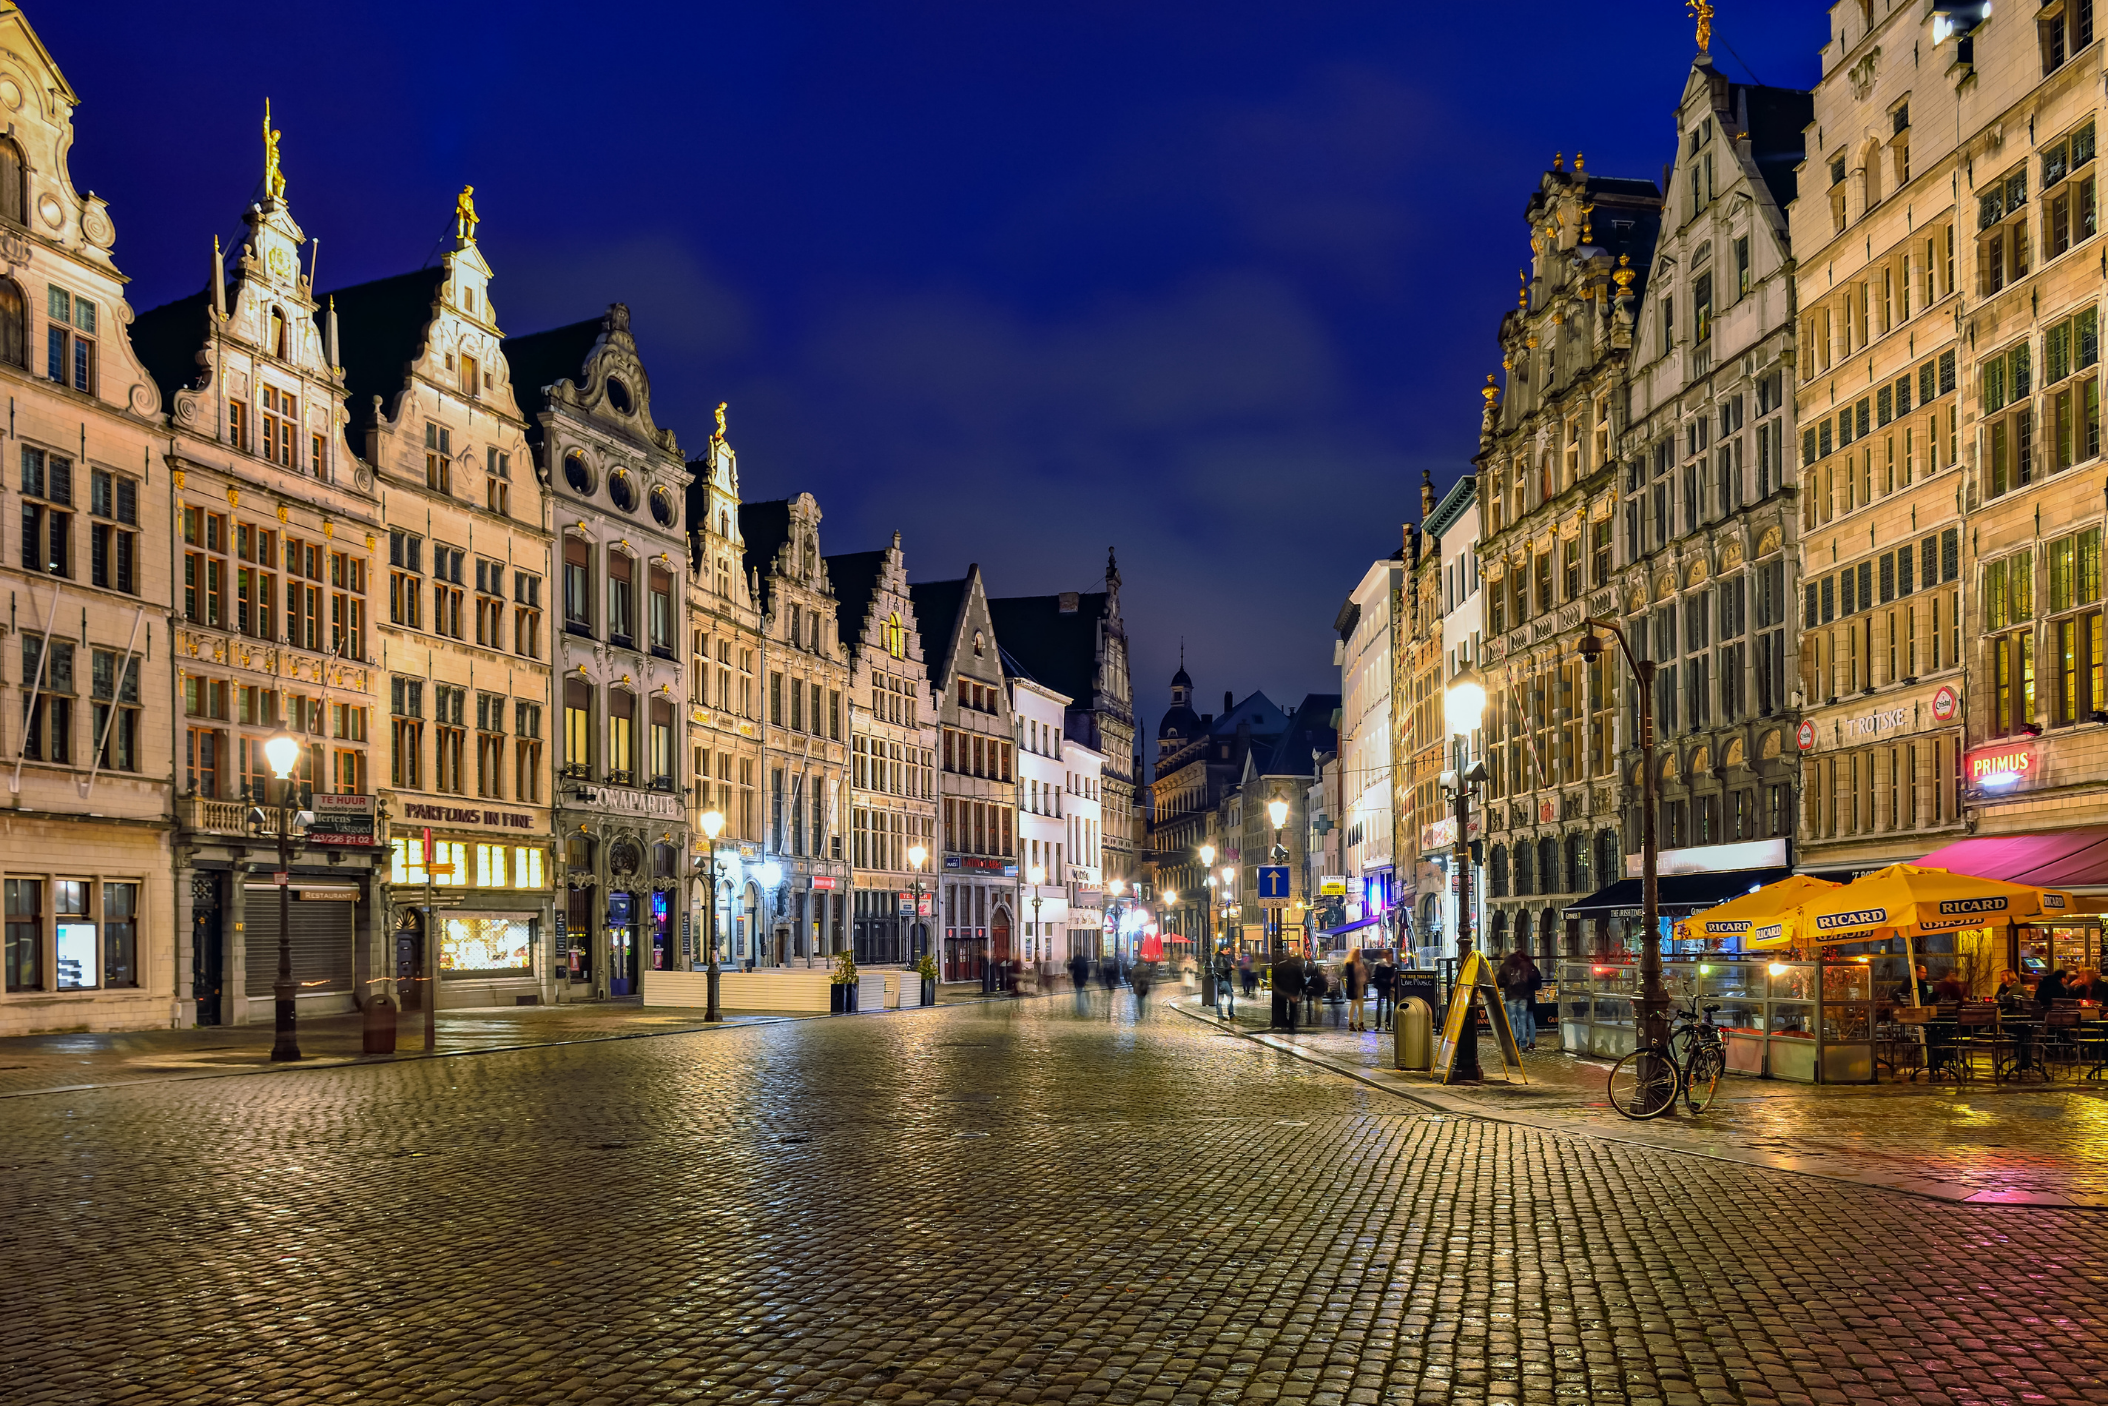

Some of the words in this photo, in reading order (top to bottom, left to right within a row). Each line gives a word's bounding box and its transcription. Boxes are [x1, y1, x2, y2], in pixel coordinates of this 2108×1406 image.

[1846, 719, 1855, 736] 'T
[1858, 708, 1906, 735] ROTSKE
[1974, 752, 2029, 776] PRIMUS
[320, 796, 333, 804] TE
[337, 796, 366, 805] HUUR
[586, 786, 674, 815] BONAPARTE
[405, 803, 480, 824] PARFUMS
[484, 811, 499, 825] IN
[502, 812, 534, 829] FINE
[334, 823, 372, 834] Vastgoed
[305, 891, 352, 899] RESTAURANT
[2044, 896, 2064, 907] RICARD
[1942, 899, 2005, 913] RICARD
[1819, 910, 1884, 928] RICARD
[1707, 922, 1751, 932] RICARD
[1756, 926, 1781, 940] RICARD
